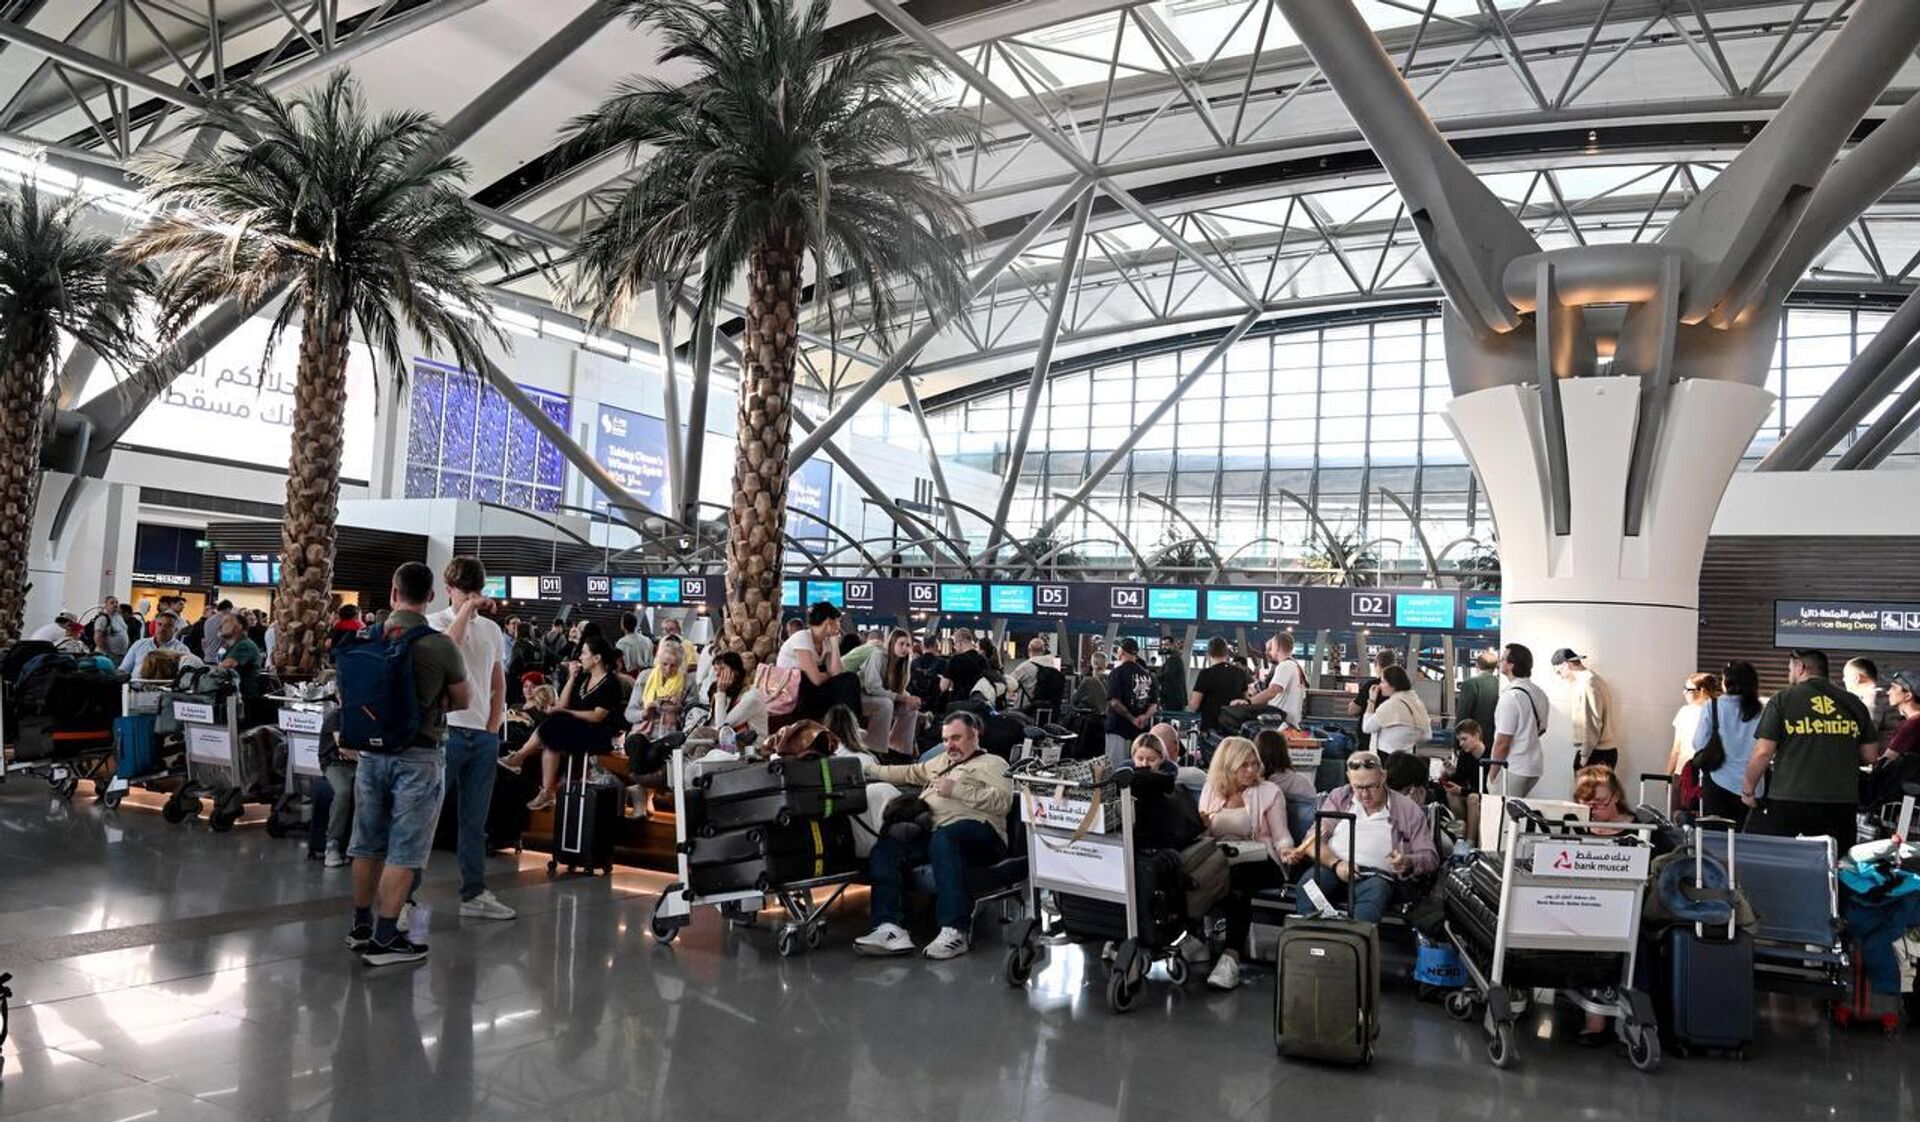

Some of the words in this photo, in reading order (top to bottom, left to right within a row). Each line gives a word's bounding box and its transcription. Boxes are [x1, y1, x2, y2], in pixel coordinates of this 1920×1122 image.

[543, 578, 559, 591] D11
[589, 579, 606, 591] D10
[686, 581, 701, 594] D9
[851, 585, 867, 598] D7
[915, 586, 932, 599] D6
[1043, 589, 1062, 603] D5
[1117, 591, 1138, 605] D4
[1270, 595, 1292, 610] D3
[1359, 597, 1382, 613] D2
[1835, 621, 1852, 631] Bag
[1854, 621, 1877, 631] Drop
[1574, 861, 1596, 871] bank
[1597, 862, 1629, 872] muscat
